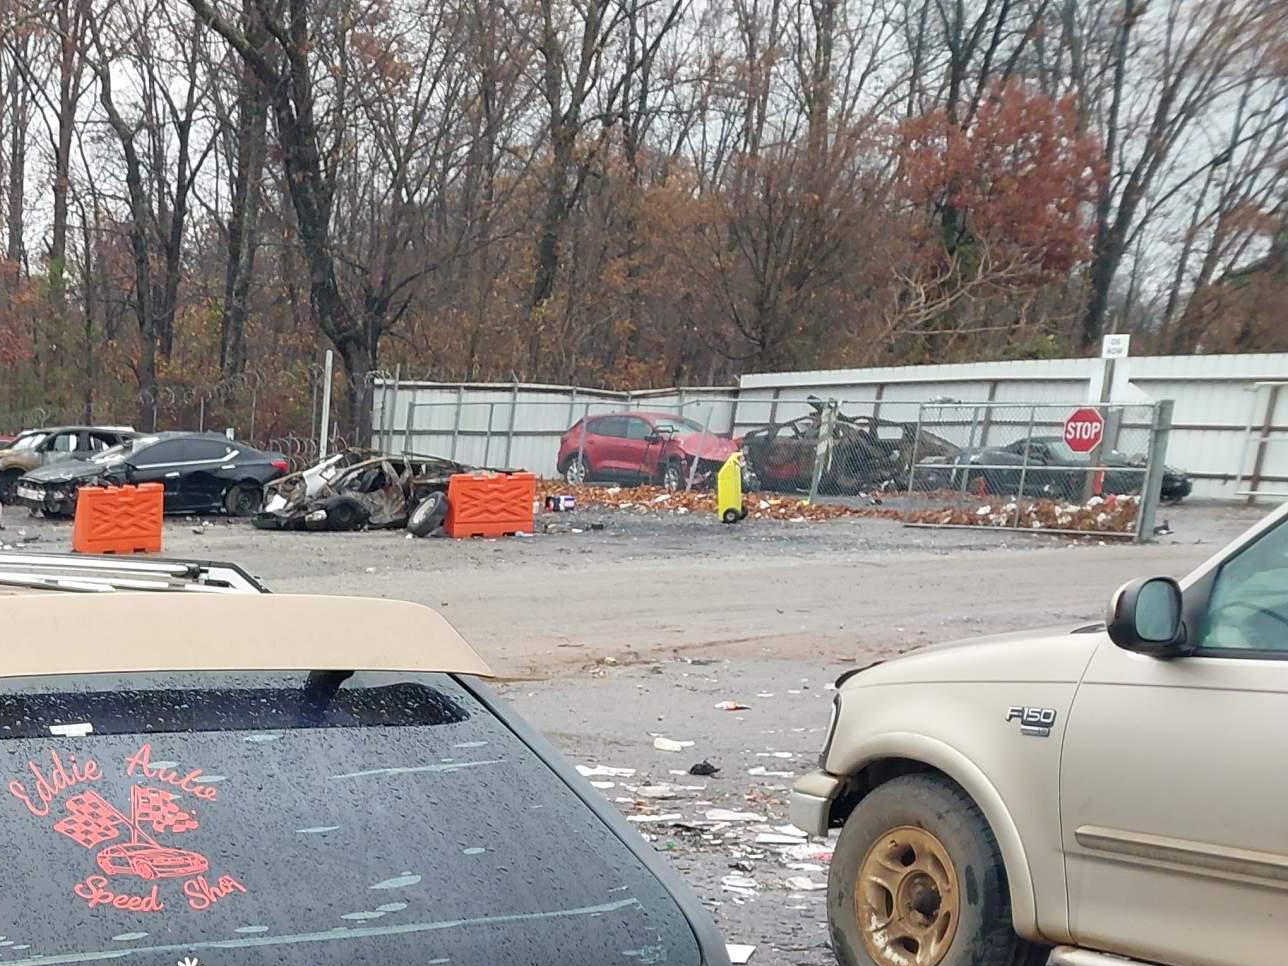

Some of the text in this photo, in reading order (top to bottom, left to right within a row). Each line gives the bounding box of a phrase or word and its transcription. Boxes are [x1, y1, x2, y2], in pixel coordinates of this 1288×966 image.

[1065, 421, 1101, 440] STOP
[8, 748, 104, 817] Eddie
[73, 875, 165, 912] Speed
